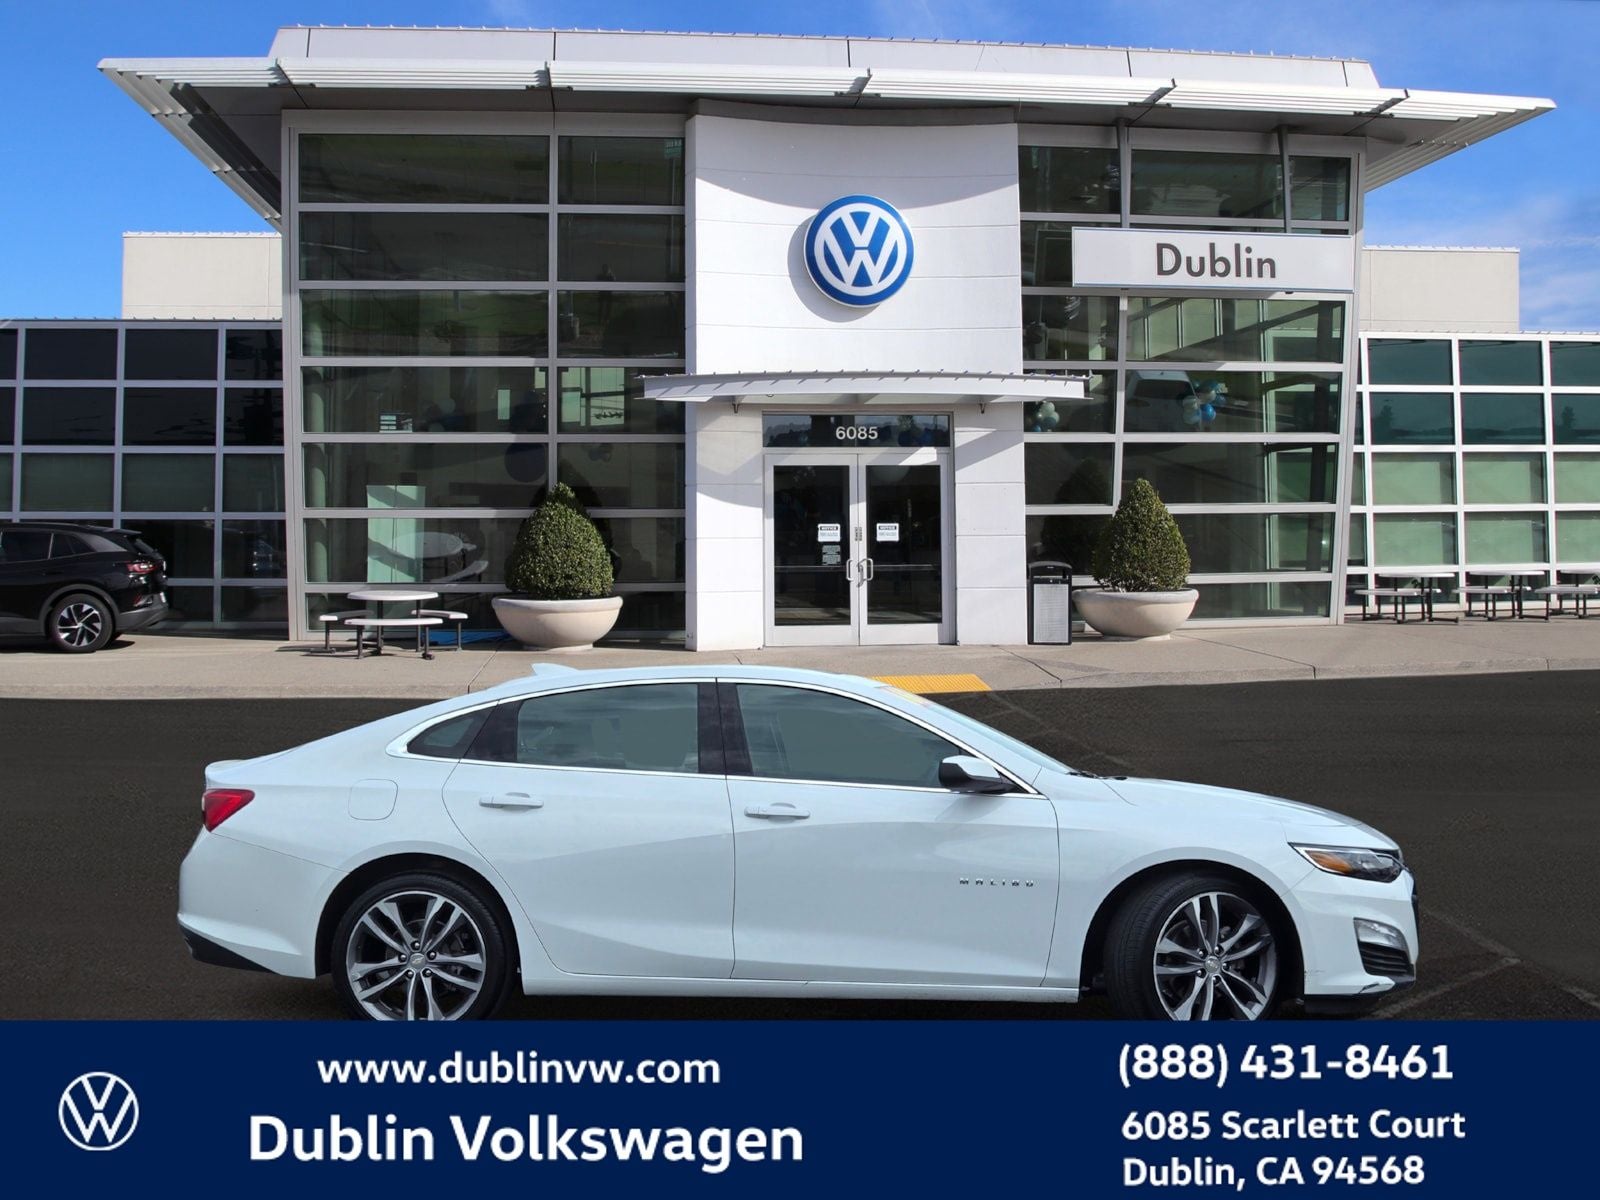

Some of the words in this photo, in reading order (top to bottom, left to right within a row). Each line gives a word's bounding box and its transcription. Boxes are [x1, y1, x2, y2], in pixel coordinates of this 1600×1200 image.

[815, 205, 905, 295] VW
[1156, 242, 1277, 279] Dublin
[835, 426, 879, 440] 6085
[959, 877, 1035, 888] MALIBU
